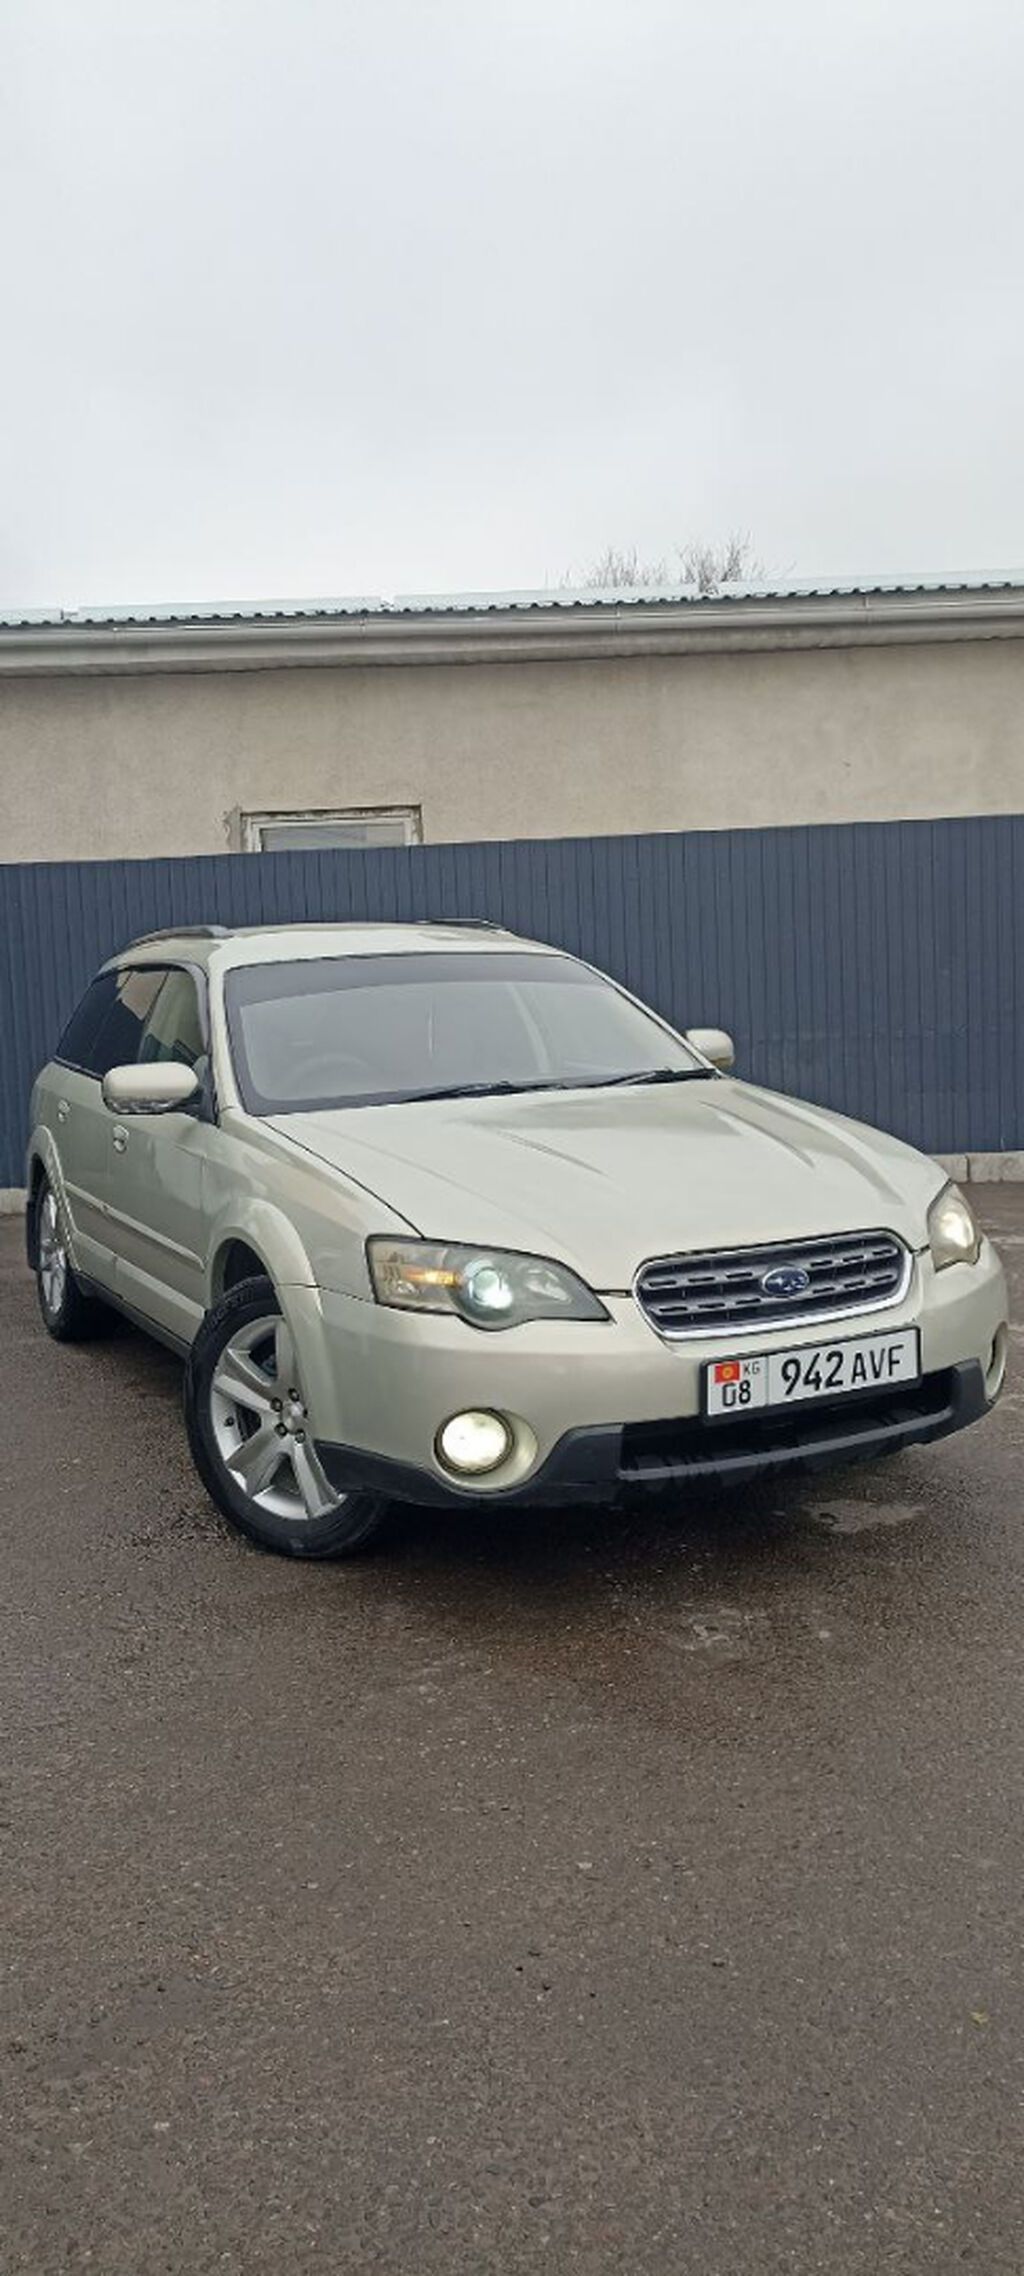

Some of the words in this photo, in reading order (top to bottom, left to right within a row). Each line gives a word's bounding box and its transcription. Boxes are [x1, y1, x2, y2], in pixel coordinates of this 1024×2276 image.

[722, 1380, 751, 1407] 08
[781, 1350, 843, 1396] 942
[851, 1344, 904, 1384] AVF
[743, 1361, 760, 1375] KG
